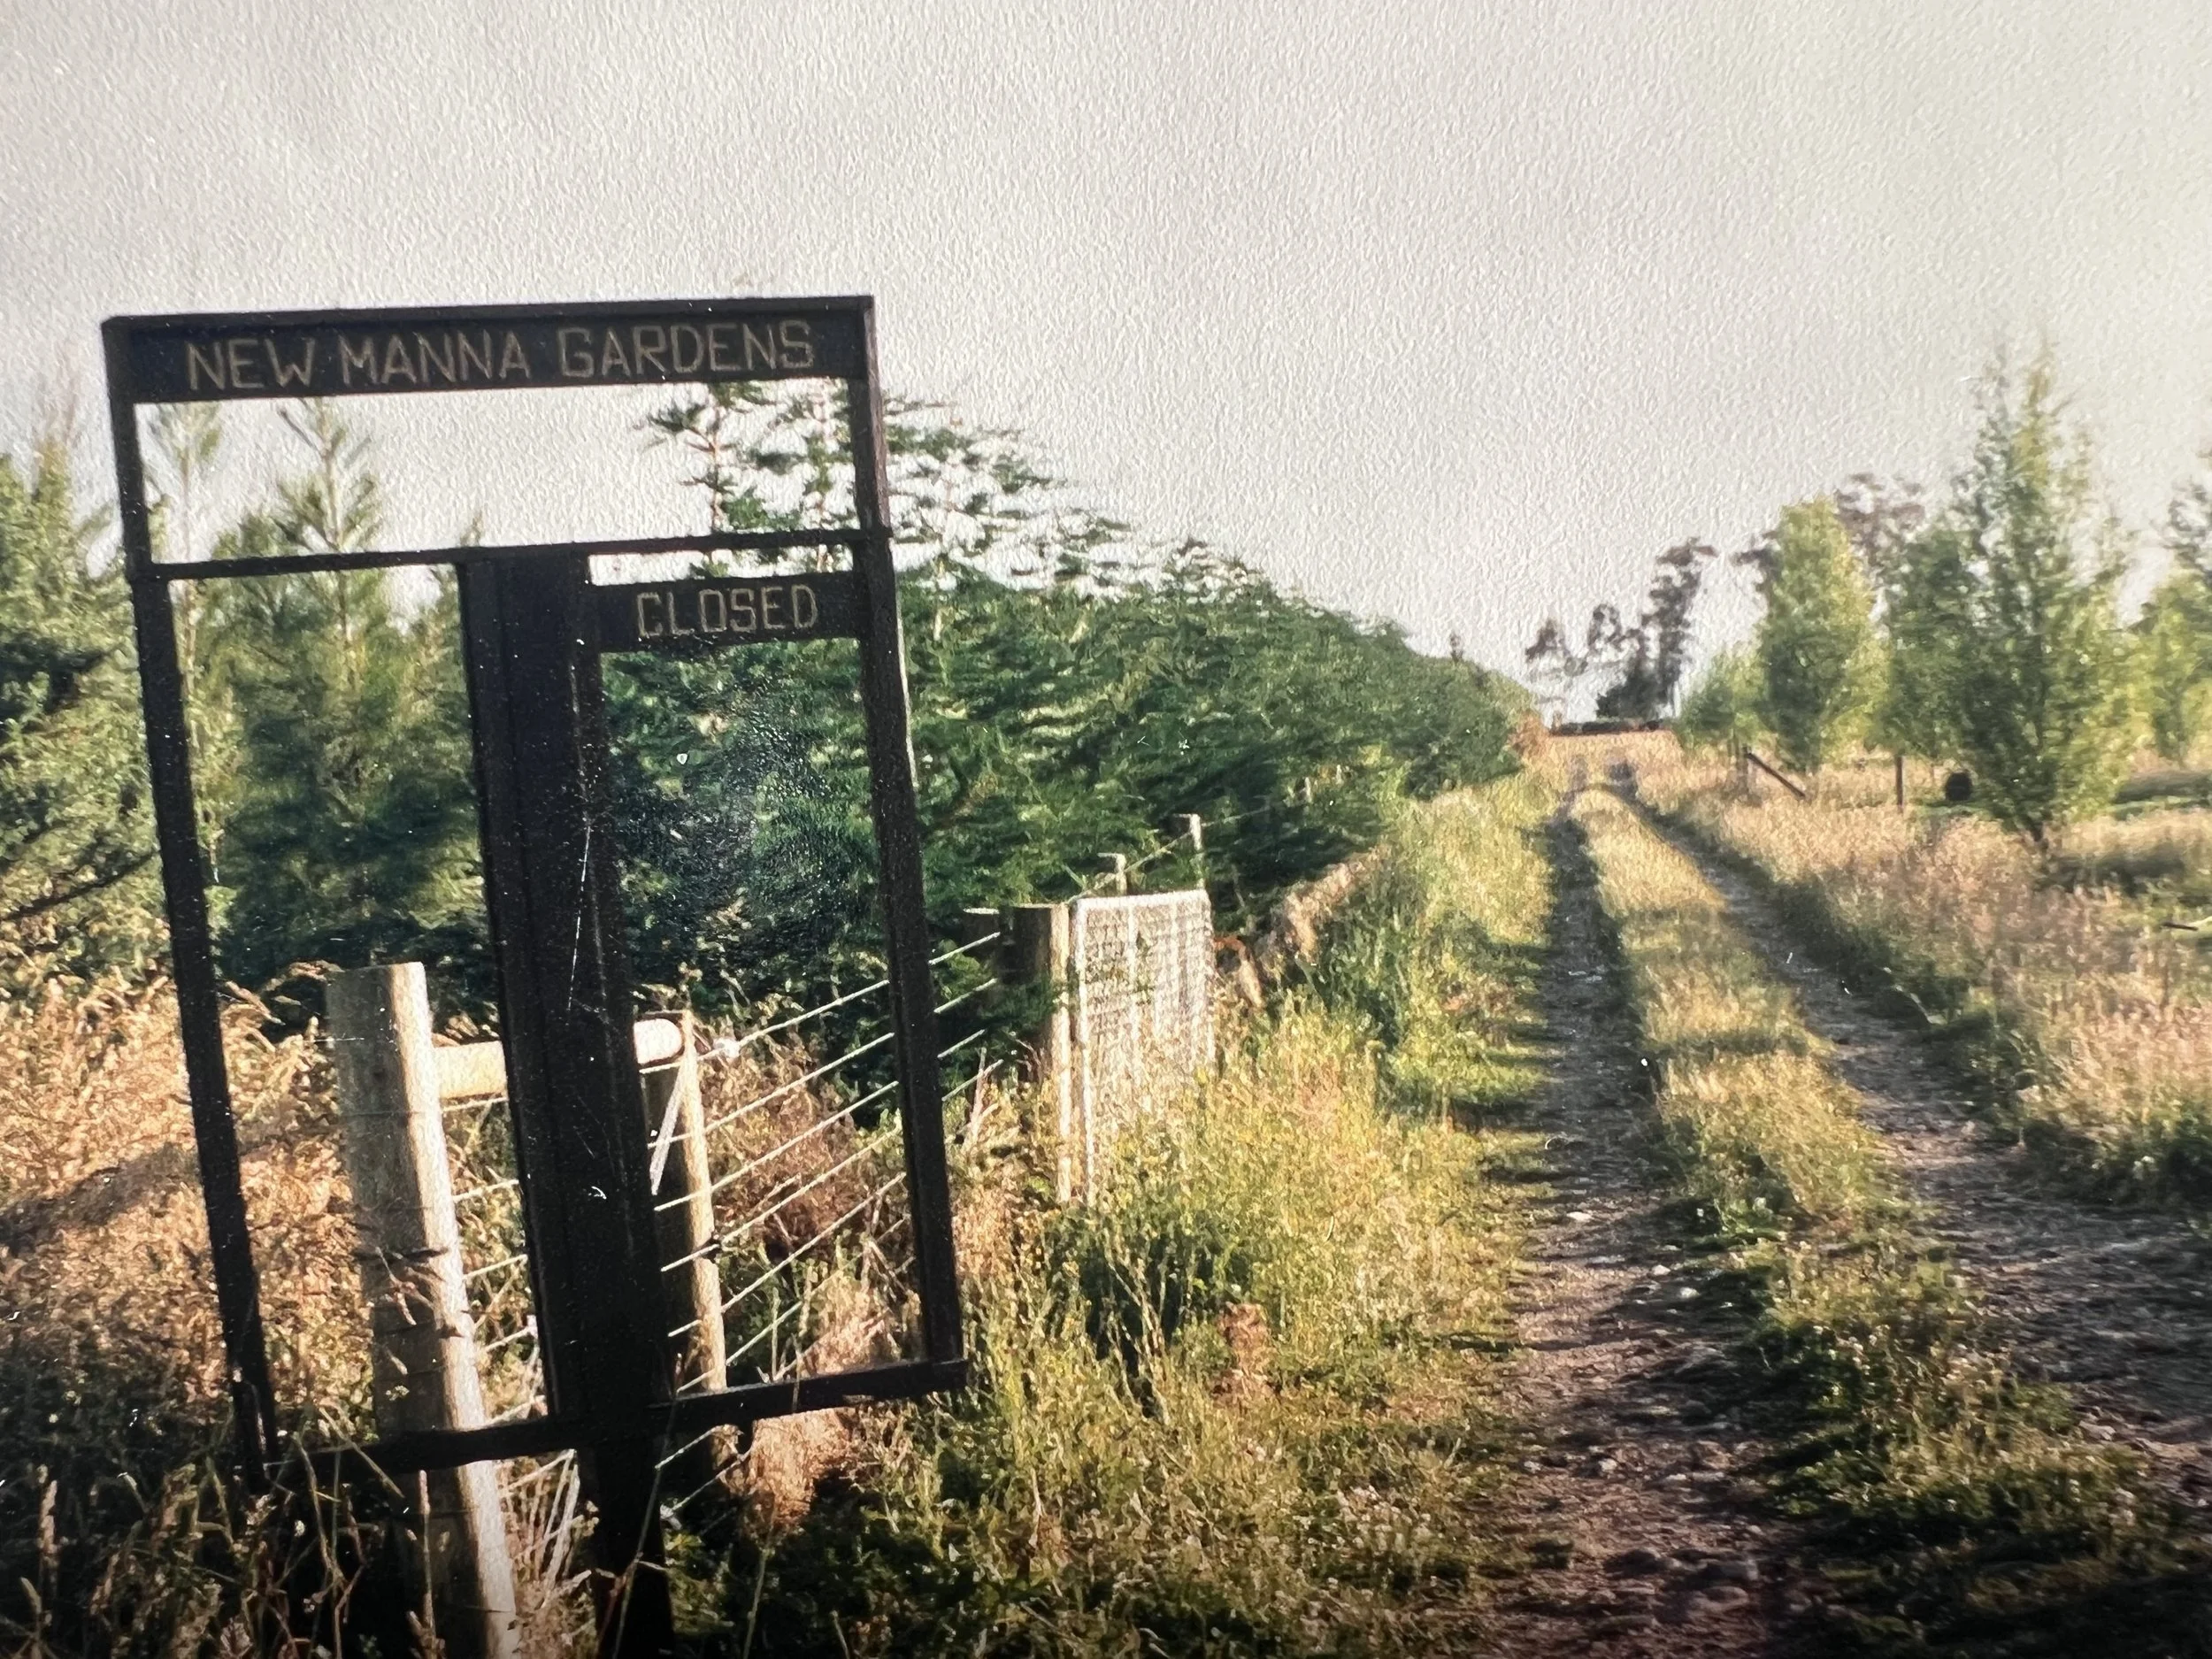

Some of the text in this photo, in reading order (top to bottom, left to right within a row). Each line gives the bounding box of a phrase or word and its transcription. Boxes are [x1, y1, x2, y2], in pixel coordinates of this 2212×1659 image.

[186, 319, 816, 391] NEW MANNA GARDENS
[636, 584, 818, 638] CLOSED
